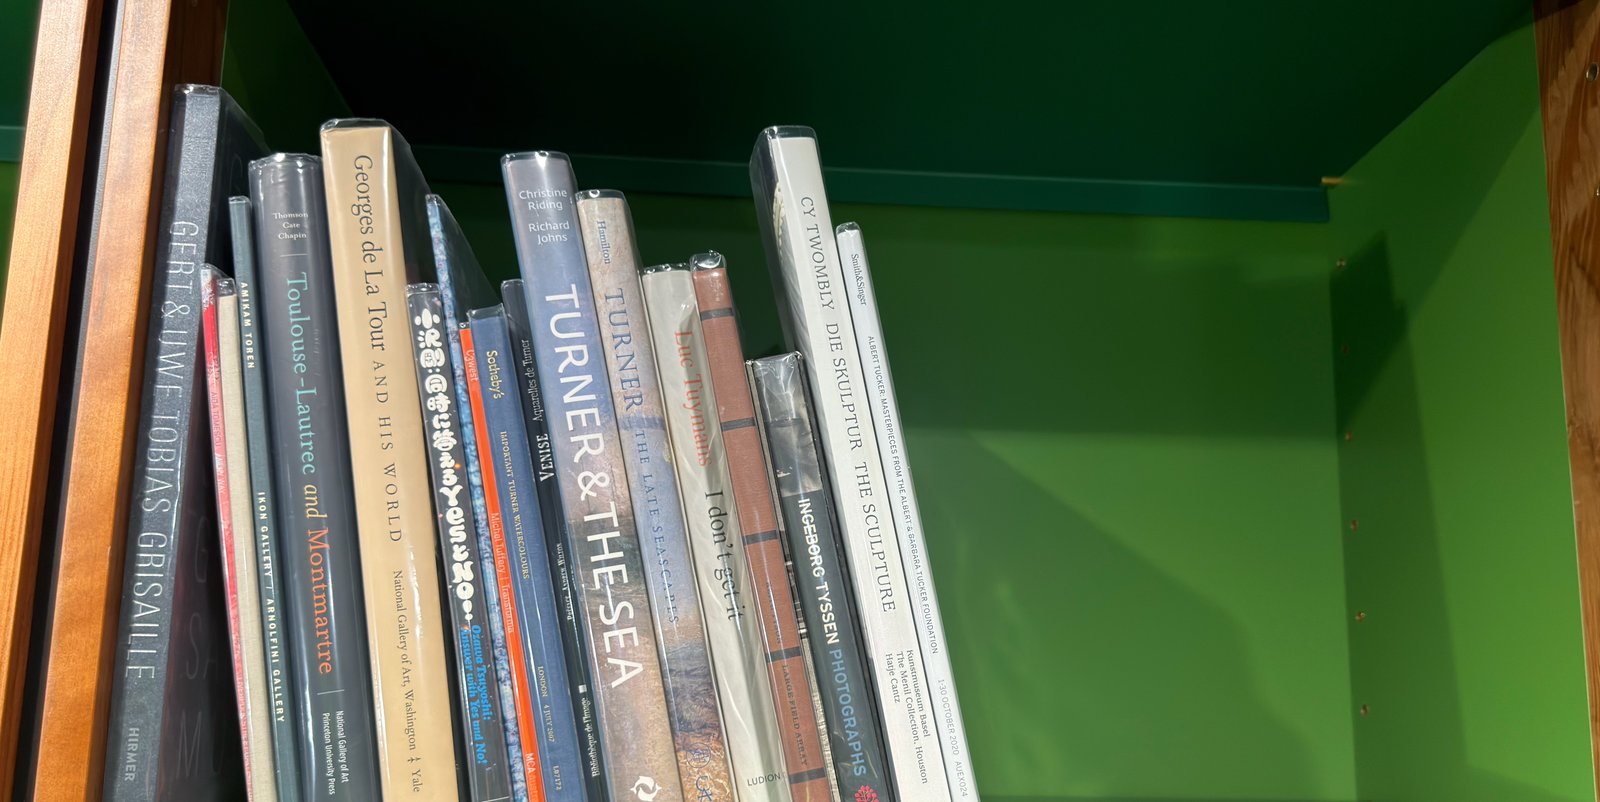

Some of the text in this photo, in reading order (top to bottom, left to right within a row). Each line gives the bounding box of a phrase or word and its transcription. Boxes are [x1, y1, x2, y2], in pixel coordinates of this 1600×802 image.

[519, 189, 567, 199] Christine
[528, 201, 563, 210] Riding
[278, 232, 307, 240] Chapin
[528, 221, 570, 232] Richard
[537, 233, 568, 245] Johns
[597, 221, 610, 264] Hamilton
[851, 253, 866, 305] Smith&Singer
[241, 282, 254, 368] AMIKAM TOREN
[351, 155, 402, 541] Georges de La Tour AND HIS WORLD
[605, 288, 643, 411] TURNER
[486, 350, 504, 399] Sotheby's
[675, 330, 711, 467] Luc Tuymans
[521, 339, 554, 481] VENISE Aquarelles de Turner
[801, 196, 896, 612] CY TWOMBLY DIE SKULPTUR THE SCULPTURE
[125, 221, 199, 679] GERT & UWE TOBIAS GRISAILLE
[287, 271, 332, 674] Toulouse-Lautrec and Montmartre
[257, 491, 267, 520] IKON
[500, 431, 530, 579] IMPORTANT TURNER WATERCOLOURS
[545, 283, 644, 689] TURNER & THE SEA
[868, 336, 879, 363] ALBERT
[874, 364, 885, 397] TUCKER:
[881, 398, 898, 454] MASTERPIECES
[891, 455, 902, 478] FROM
[897, 477, 905, 493] THE
[901, 493, 911, 524] ALBERT
[908, 534, 921, 571] BARBARA
[915, 571, 927, 602] TUCKER
[921, 604, 938, 654] FOUNDATION
[261, 526, 272, 578] GALLERY
[491, 512, 503, 547] Michel
[635, 431, 679, 624] THE LATE SEASCAPES
[496, 547, 507, 575] Tuffery
[705, 490, 745, 622] I don't get it
[266, 598, 279, 662] ARNOLFINI
[798, 498, 867, 777] INGEBORG TYSSEN PHOTOGRAPHS
[272, 670, 284, 722] GALLERY
[393, 570, 423, 792] National Gallery of Art, Washington Yale
[467, 673, 478, 697] with
[477, 664, 493, 721] Tsuyoshi:
[538, 665, 548, 697] LONDON
[885, 653, 900, 703] Hatje Cantz
[906, 650, 931, 738] Kunstmuseum Basel
[336, 711, 346, 738] National
[470, 699, 480, 718] Yes
[473, 720, 483, 740] and
[782, 665, 807, 766] LARGE FIELD ARRAY
[900, 670, 911, 695] Menil
[916, 746, 928, 784] Houston
[942, 697, 955, 734] OCTOBER
[950, 735, 959, 756] 2020
[124, 727, 140, 782] HIRMER
[322, 712, 336, 795] Princeton University Press
[338, 739, 347, 763] Gallery
[475, 744, 488, 765] No!
[526, 753, 536, 773] MCA
[341, 772, 349, 783] Art
[747, 772, 781, 787] LUDION
